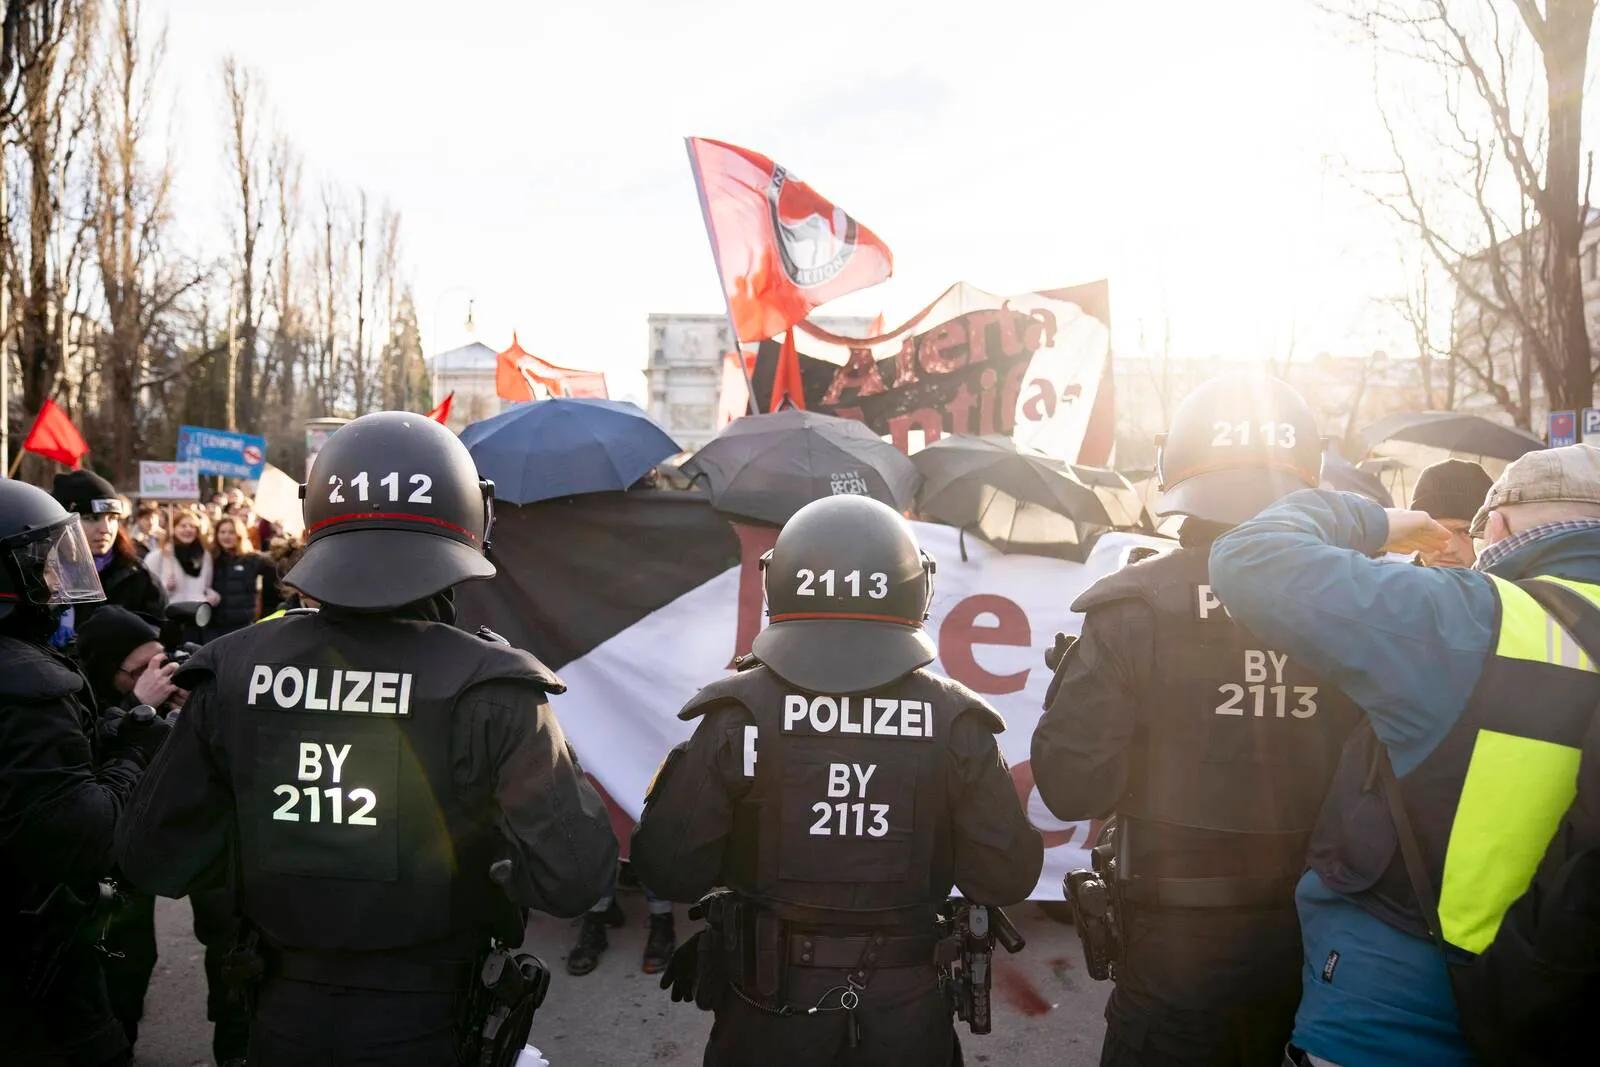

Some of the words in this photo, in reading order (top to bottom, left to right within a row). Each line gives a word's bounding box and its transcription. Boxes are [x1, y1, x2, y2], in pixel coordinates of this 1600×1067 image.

[822, 300, 1058, 405] Alerta
[1211, 420, 1297, 449] 2113
[328, 471, 433, 504] 2112
[796, 569, 888, 599] 2113
[1244, 650, 1289, 684] BY
[247, 665, 413, 714] POLIZEI
[1215, 683, 1319, 719] 2113
[783, 694, 934, 738] POLIZEI
[298, 742, 353, 783] BY
[827, 763, 877, 798] BY
[272, 784, 377, 826] 2112
[809, 801, 890, 837] 2113
